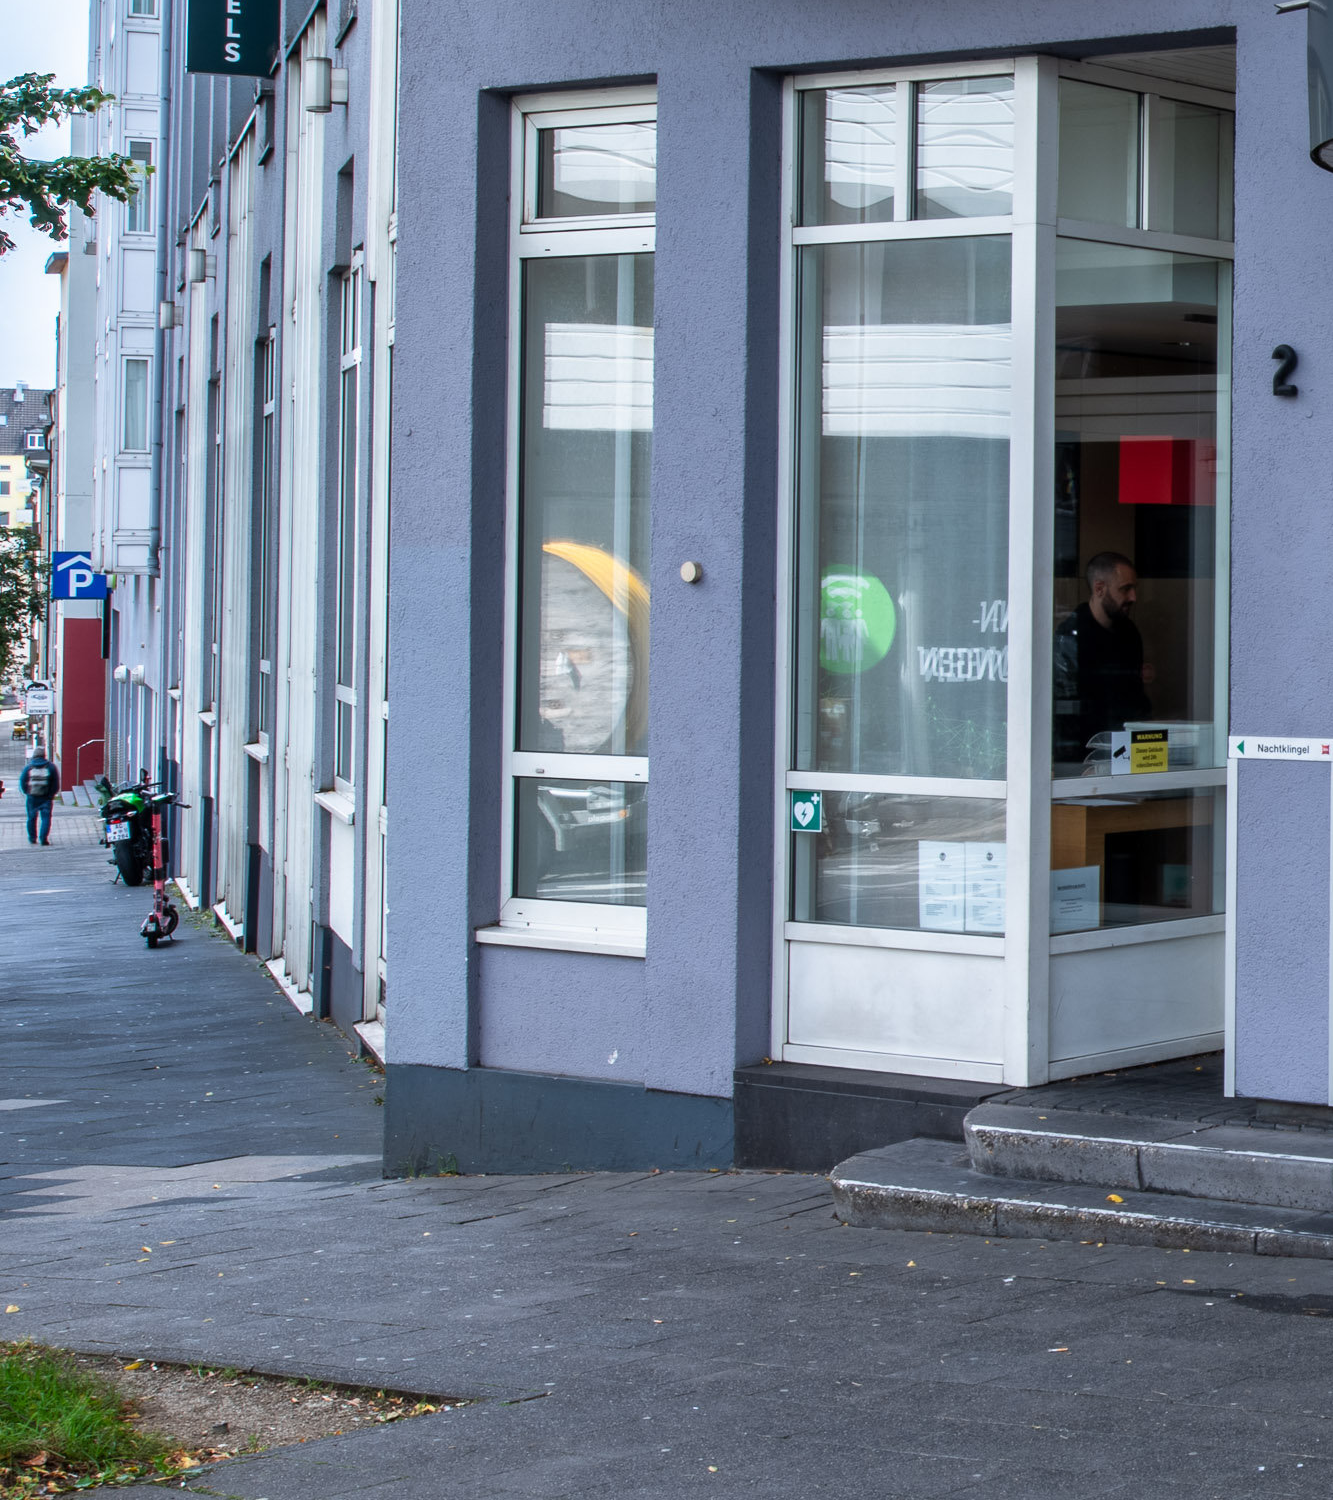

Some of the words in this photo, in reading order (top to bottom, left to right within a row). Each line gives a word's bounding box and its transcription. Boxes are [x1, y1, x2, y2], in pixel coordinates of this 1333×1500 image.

[1271, 344, 1298, 397] 2
[69, 569, 93, 597] P
[1257, 744, 1310, 755] Nachtklingel
